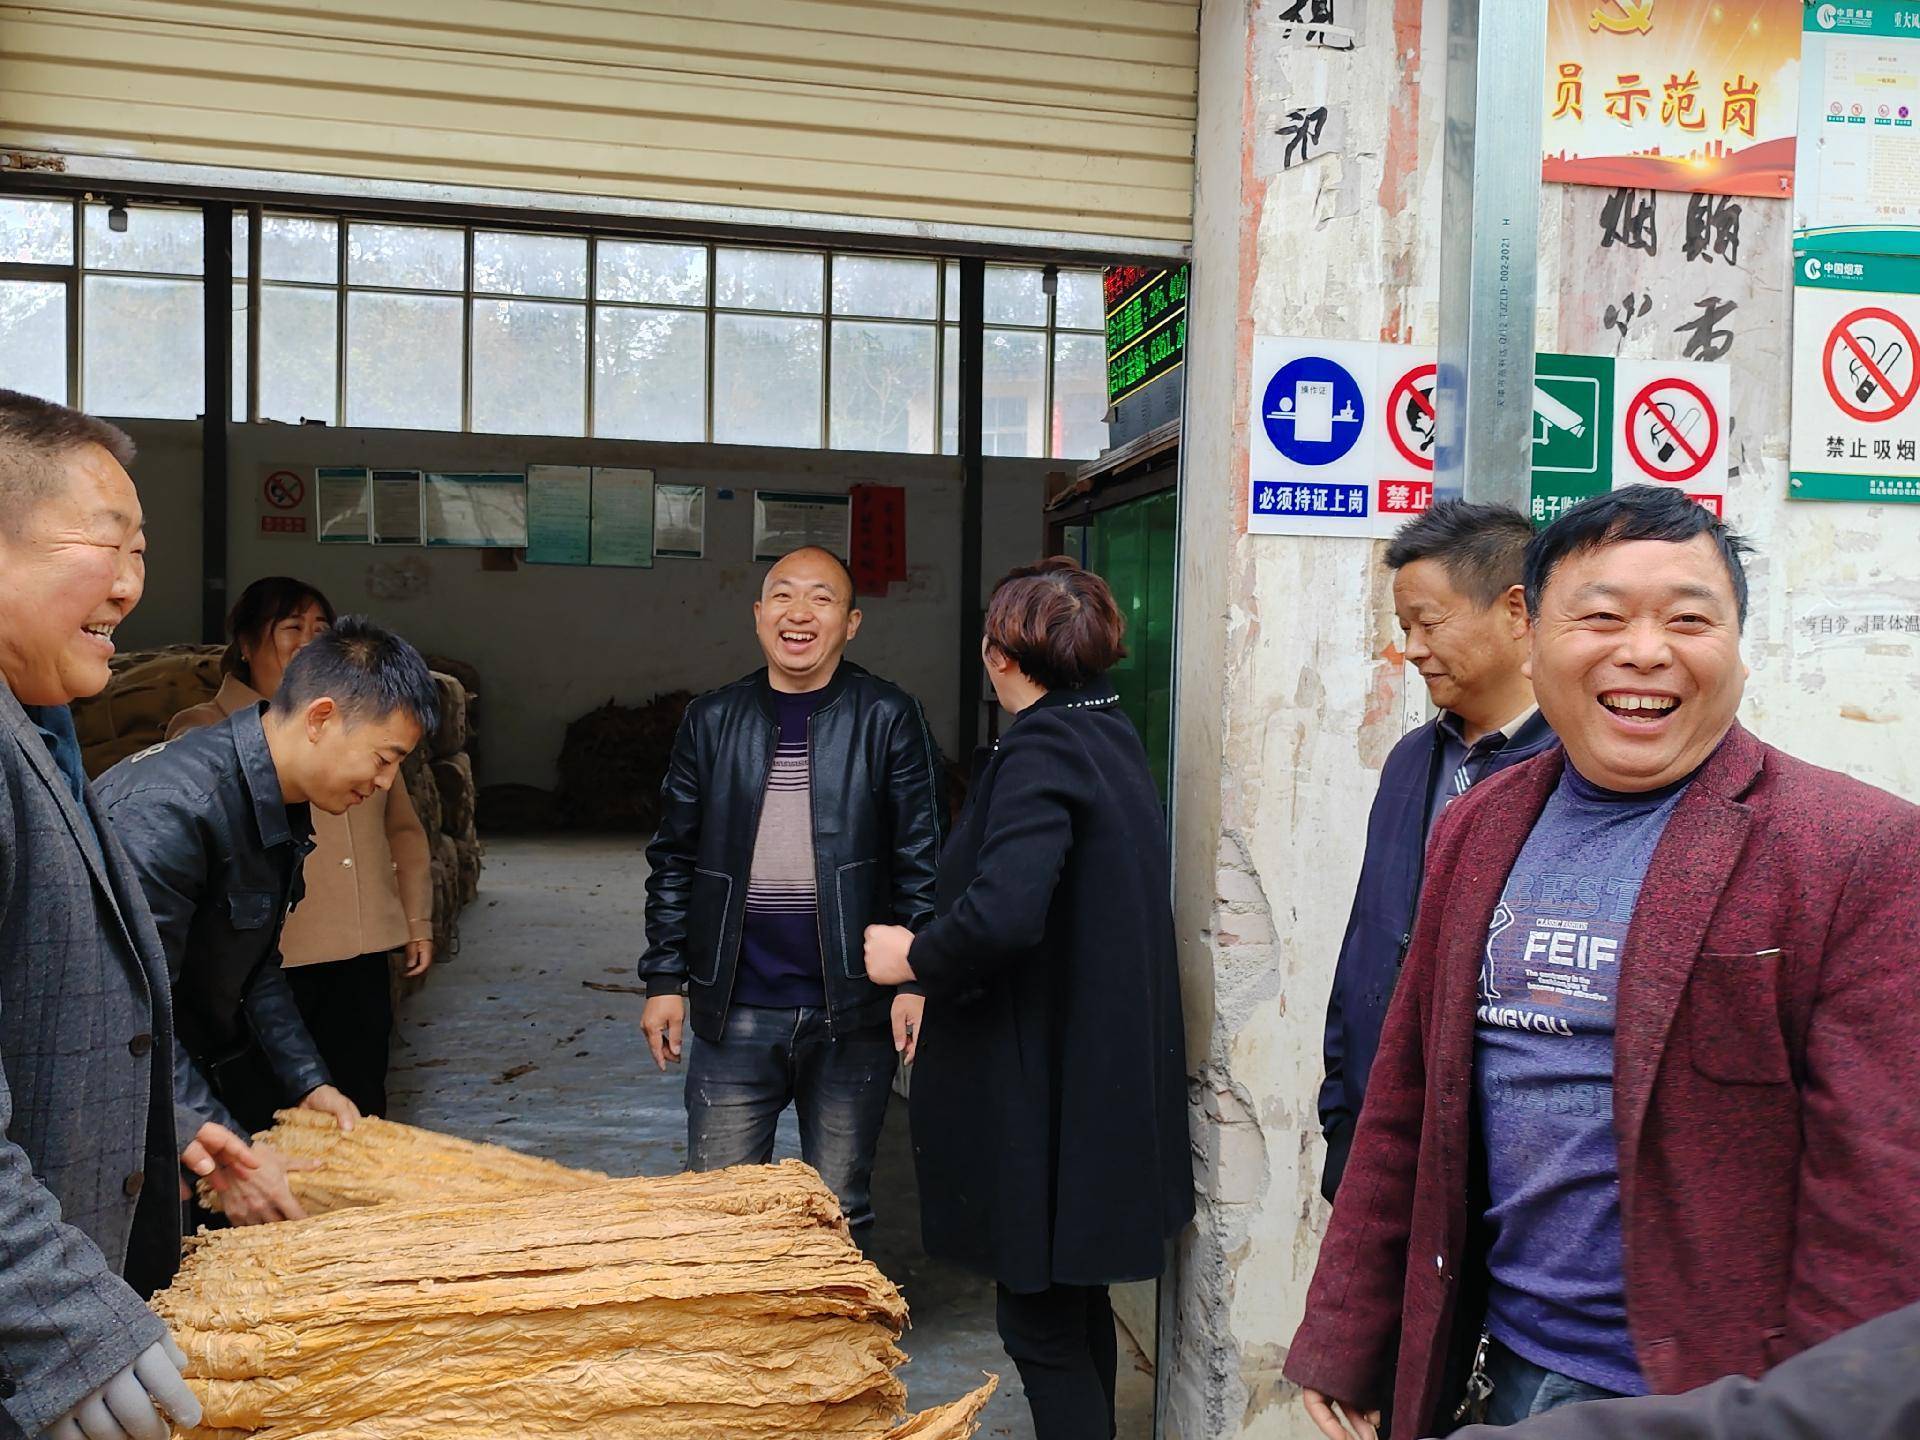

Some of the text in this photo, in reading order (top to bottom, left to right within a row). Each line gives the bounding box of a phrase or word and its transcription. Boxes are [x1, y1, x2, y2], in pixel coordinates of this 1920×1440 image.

[1551, 62, 1760, 138] 员示范岗
[1824, 262, 1863, 275] 中国烟草
[1301, 385, 1327, 396] 操作证
[1826, 435, 1916, 461] 禁止吸烟
[1259, 486, 1364, 514] 必须持证上岗
[1523, 930, 1618, 971] FEIF
